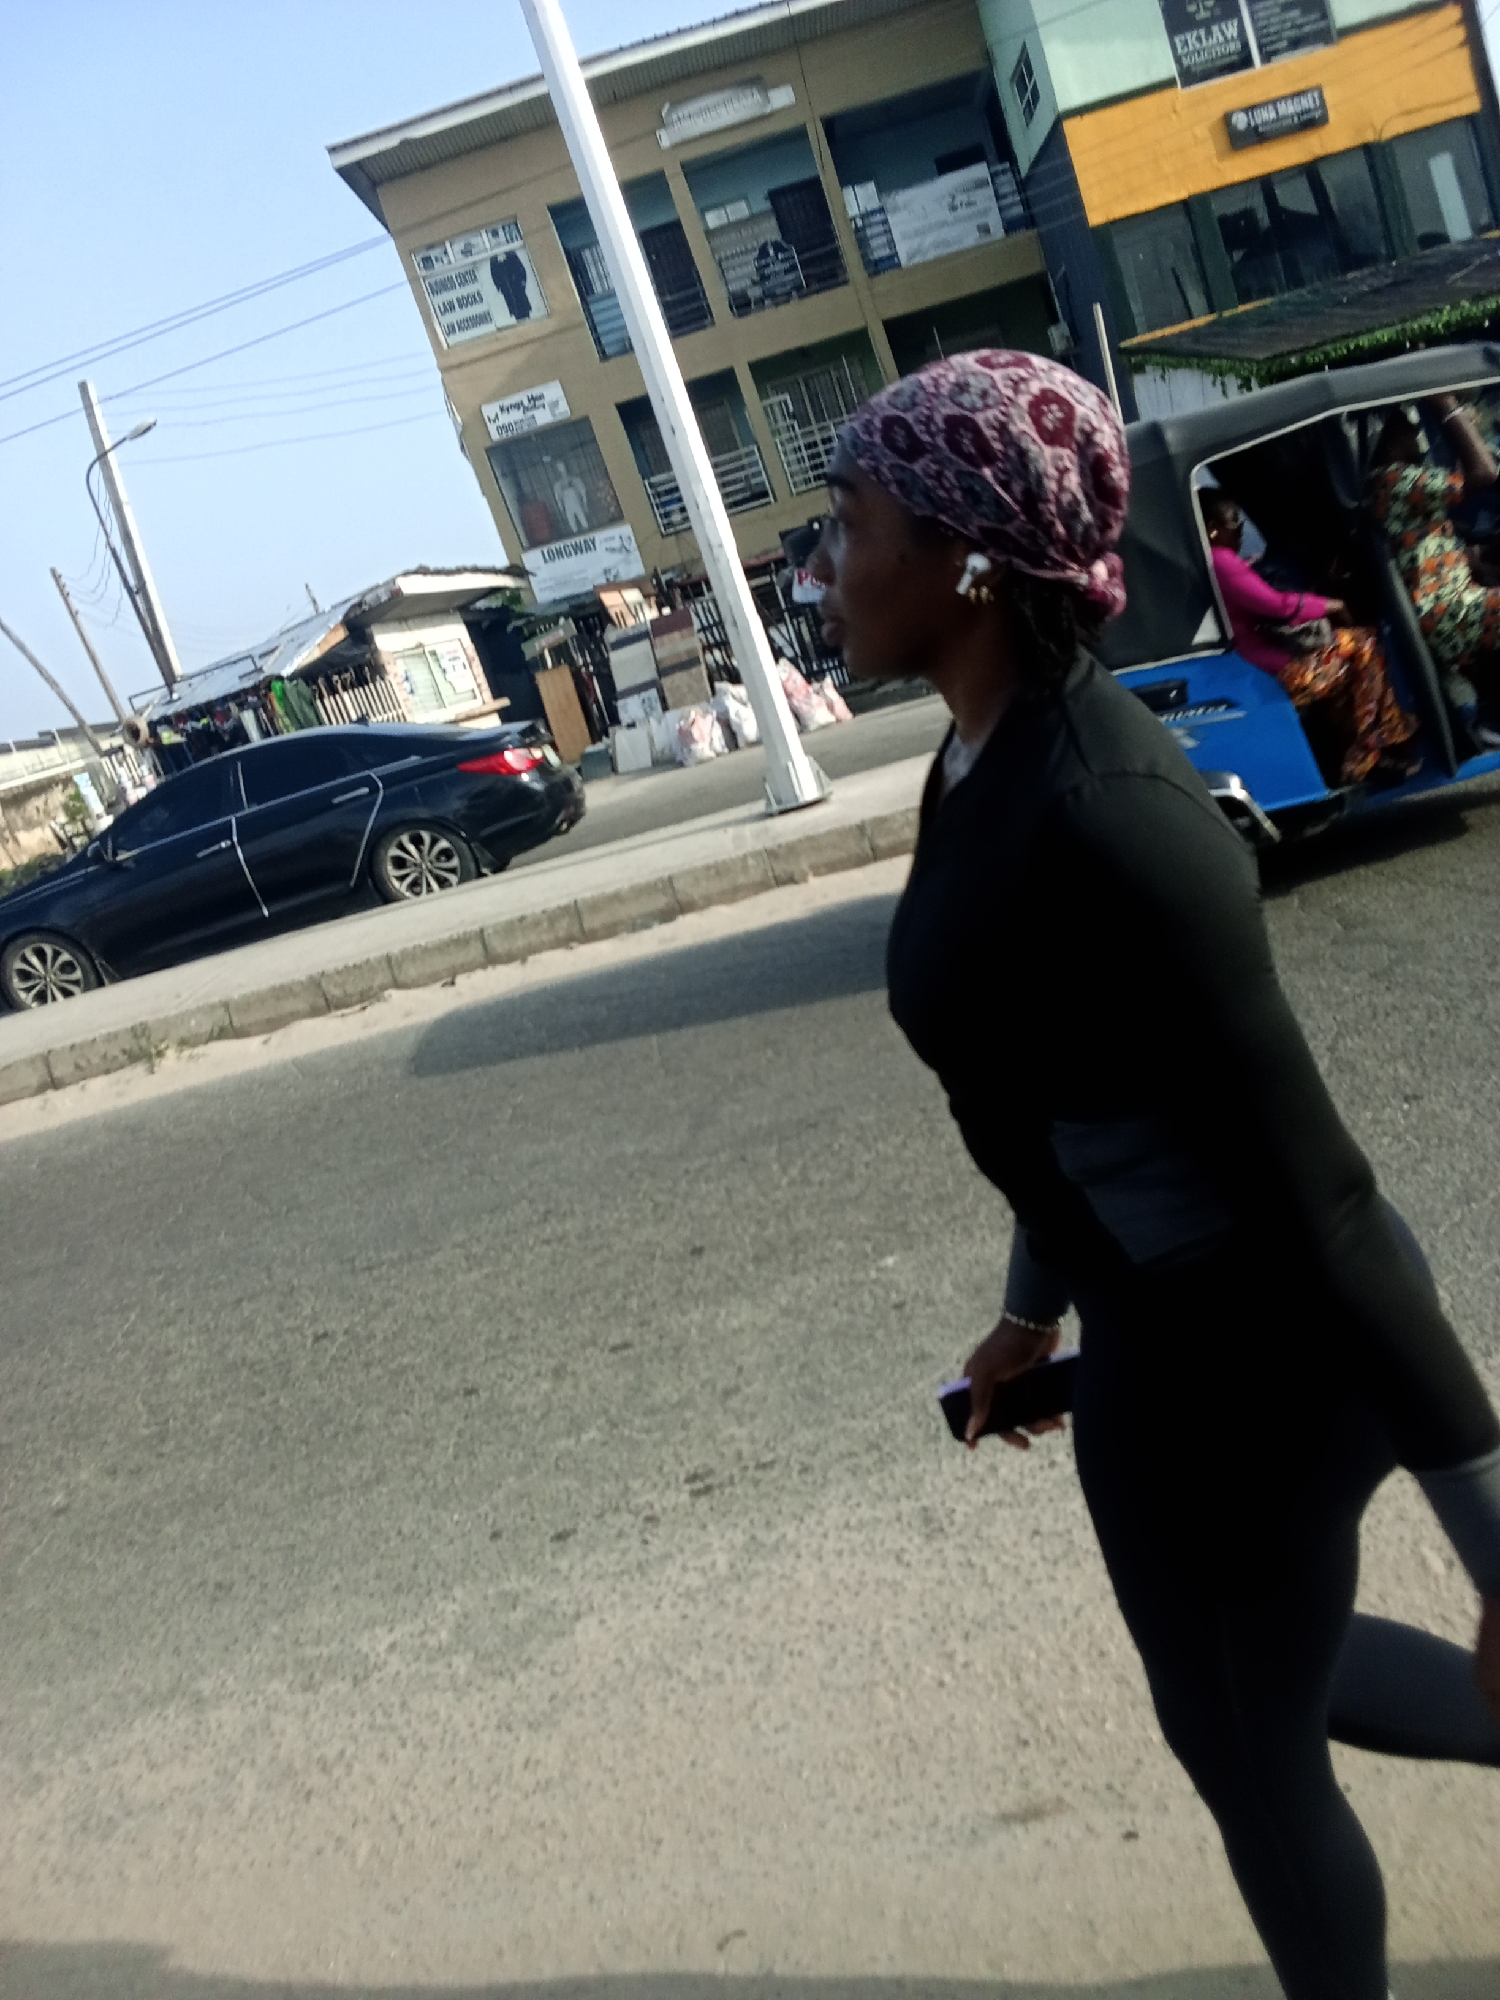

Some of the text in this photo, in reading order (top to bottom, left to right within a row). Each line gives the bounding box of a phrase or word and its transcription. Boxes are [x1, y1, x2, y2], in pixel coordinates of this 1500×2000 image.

[1173, 18, 1239, 56] EKLAW
[437, 289, 484, 317] LAW BOOKS
[540, 536, 597, 564] LONGWAY
